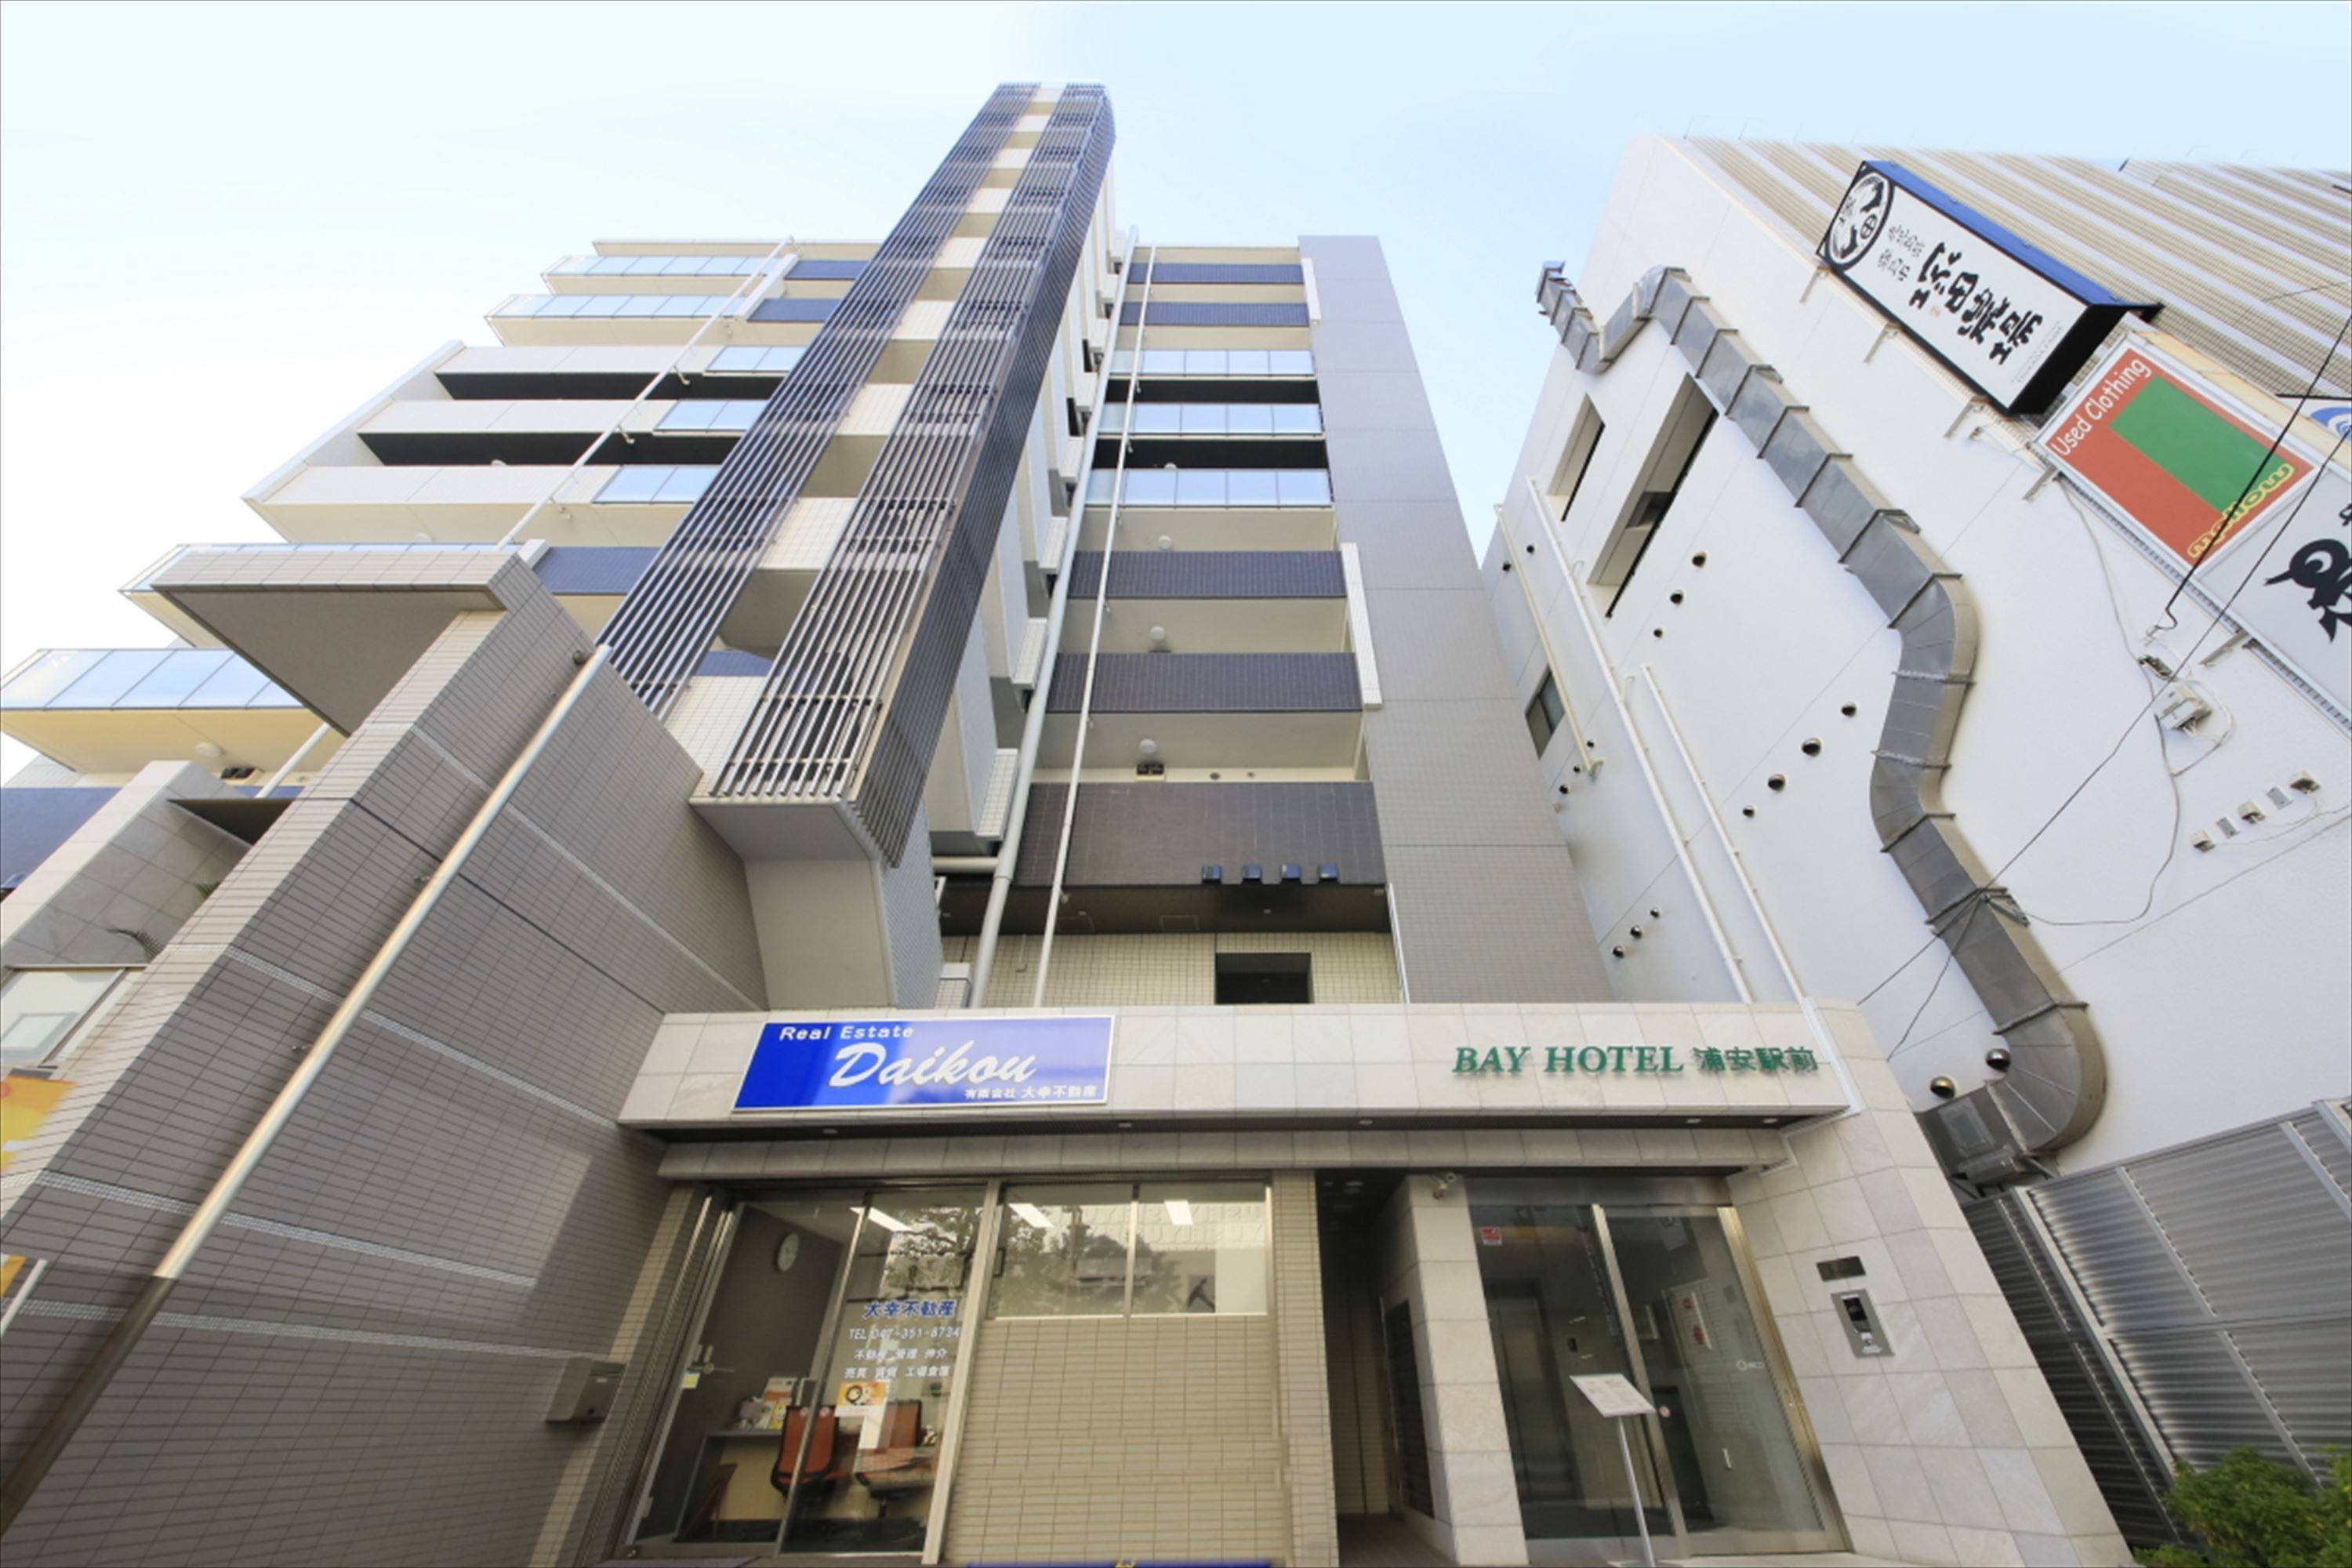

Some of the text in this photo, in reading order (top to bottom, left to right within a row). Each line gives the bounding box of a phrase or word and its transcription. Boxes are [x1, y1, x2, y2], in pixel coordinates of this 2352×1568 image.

[2049, 359, 2152, 456] Used Clothing
[779, 1025, 914, 1040] Real Estate
[829, 1040, 1037, 1087] Daikou
[1452, 1046, 1819, 1073] BAY HOTEL 浦安駅前
[1022, 1085, 1097, 1098] 大幸不動産
[863, 1300, 956, 1319] 大幸不動産
[848, 1328, 867, 1340] TEL
